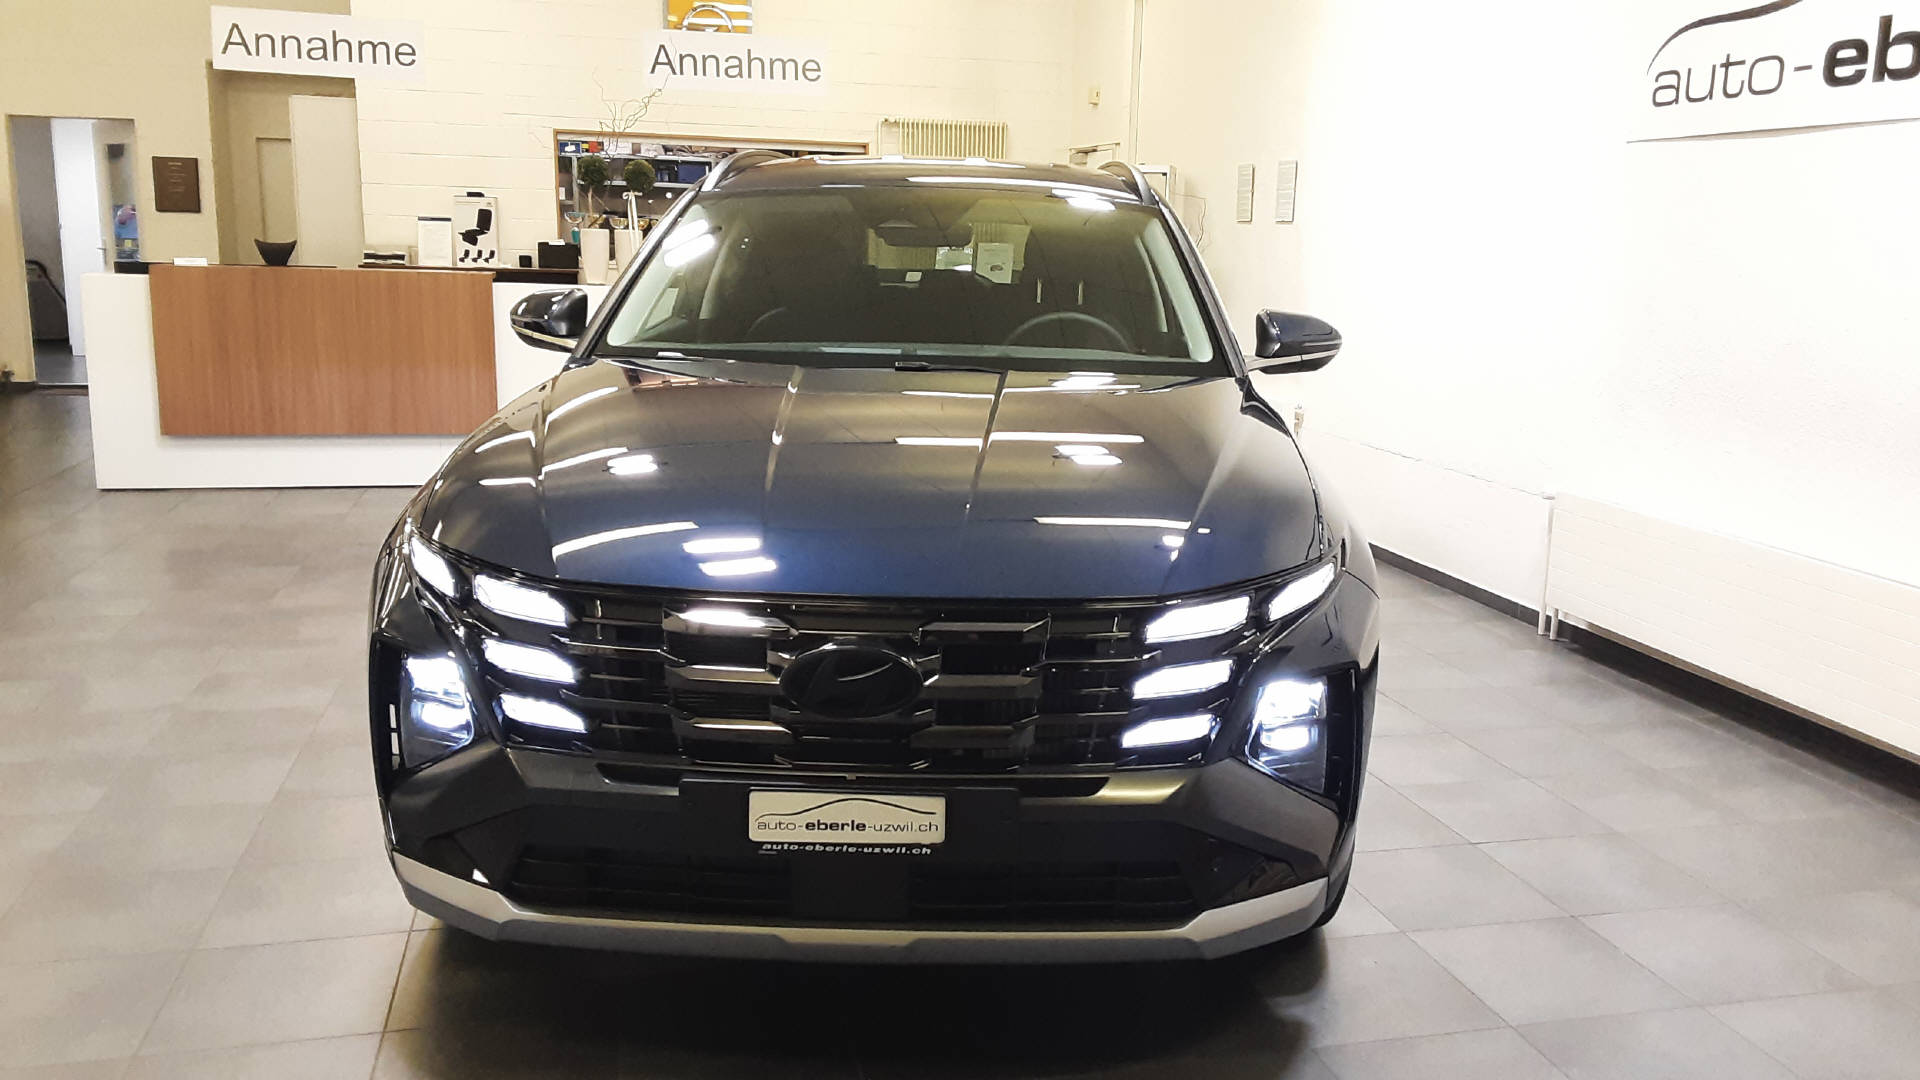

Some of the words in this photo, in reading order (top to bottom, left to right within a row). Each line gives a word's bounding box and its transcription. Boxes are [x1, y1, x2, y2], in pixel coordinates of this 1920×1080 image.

[221, 22, 417, 67] Annahme
[650, 44, 822, 82] Annahme
[757, 819, 939, 833] auto-eberle-uzwil.ch
[762, 843, 932, 855] auto-eberle-uzwil.ch
